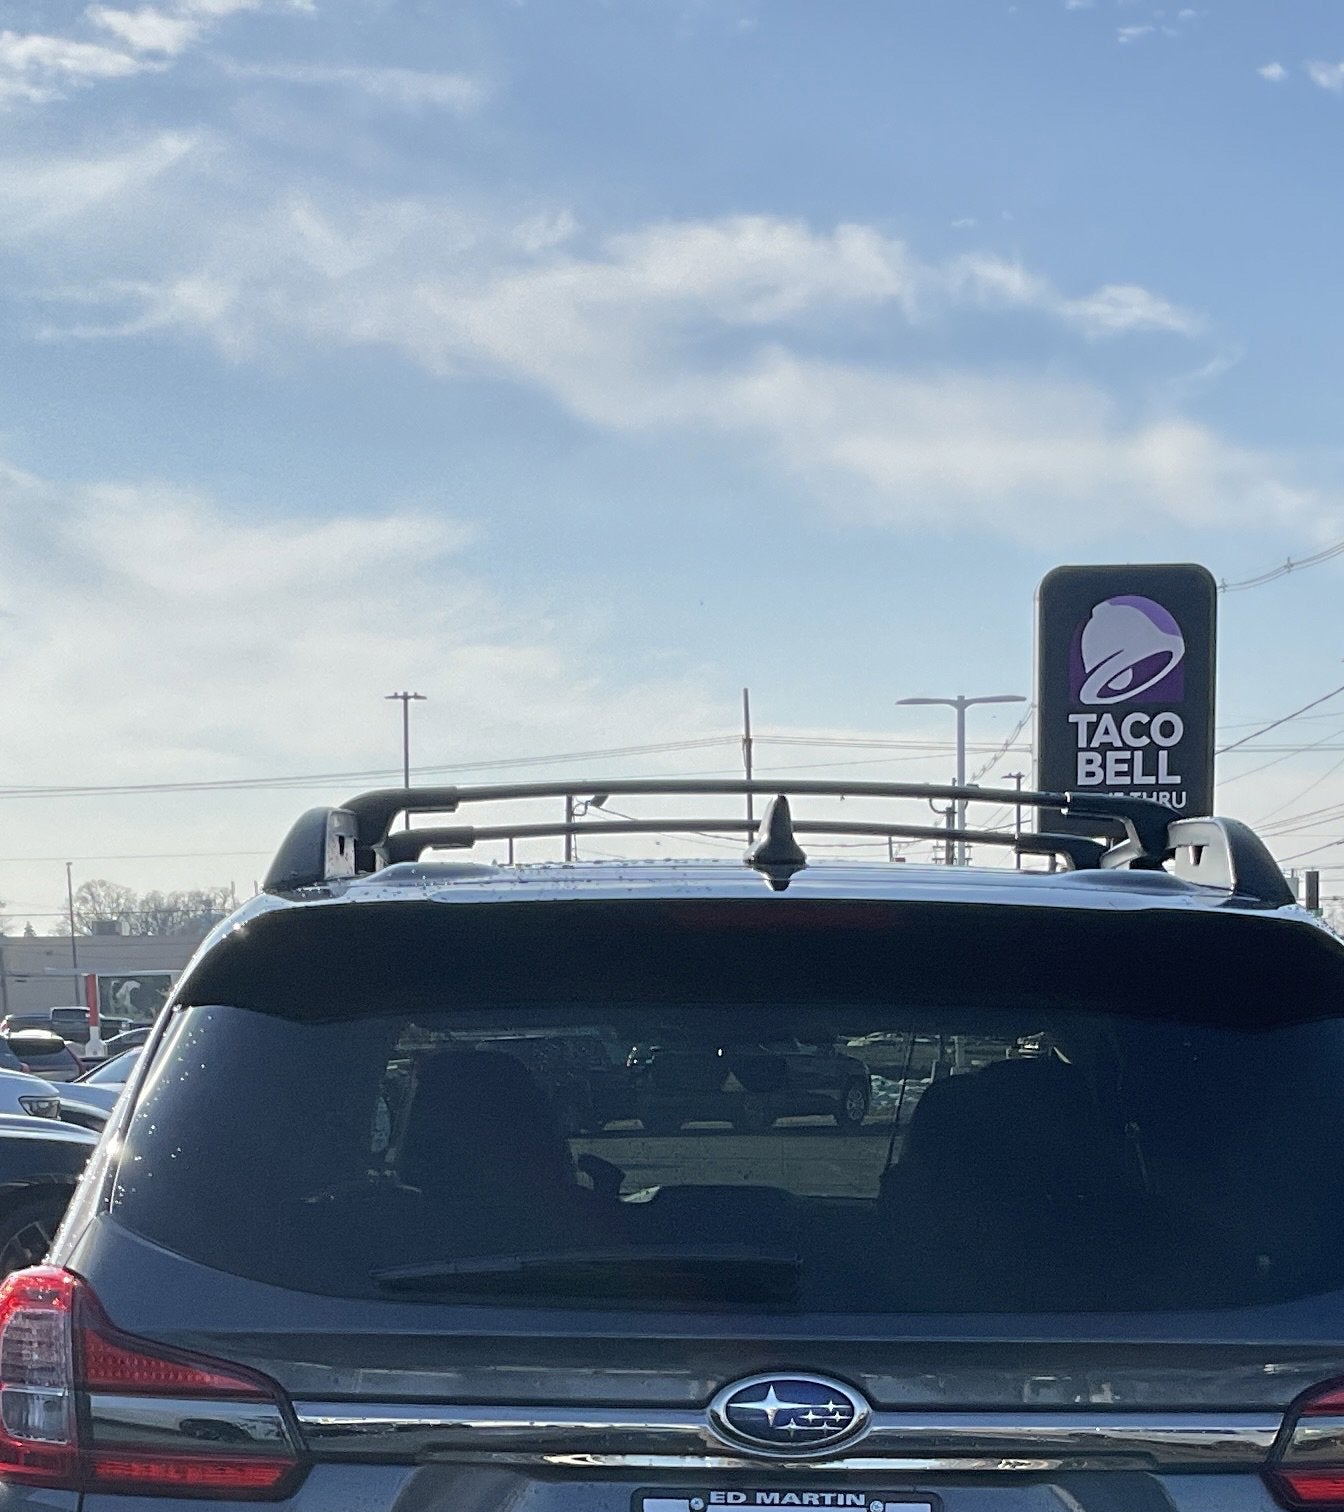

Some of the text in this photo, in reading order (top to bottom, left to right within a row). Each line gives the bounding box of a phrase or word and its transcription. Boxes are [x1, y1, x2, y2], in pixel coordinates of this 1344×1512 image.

[1068, 711, 1184, 748] TACO
[1077, 750, 1181, 786] BELL
[709, 1490, 866, 1506] ED MARTIN
